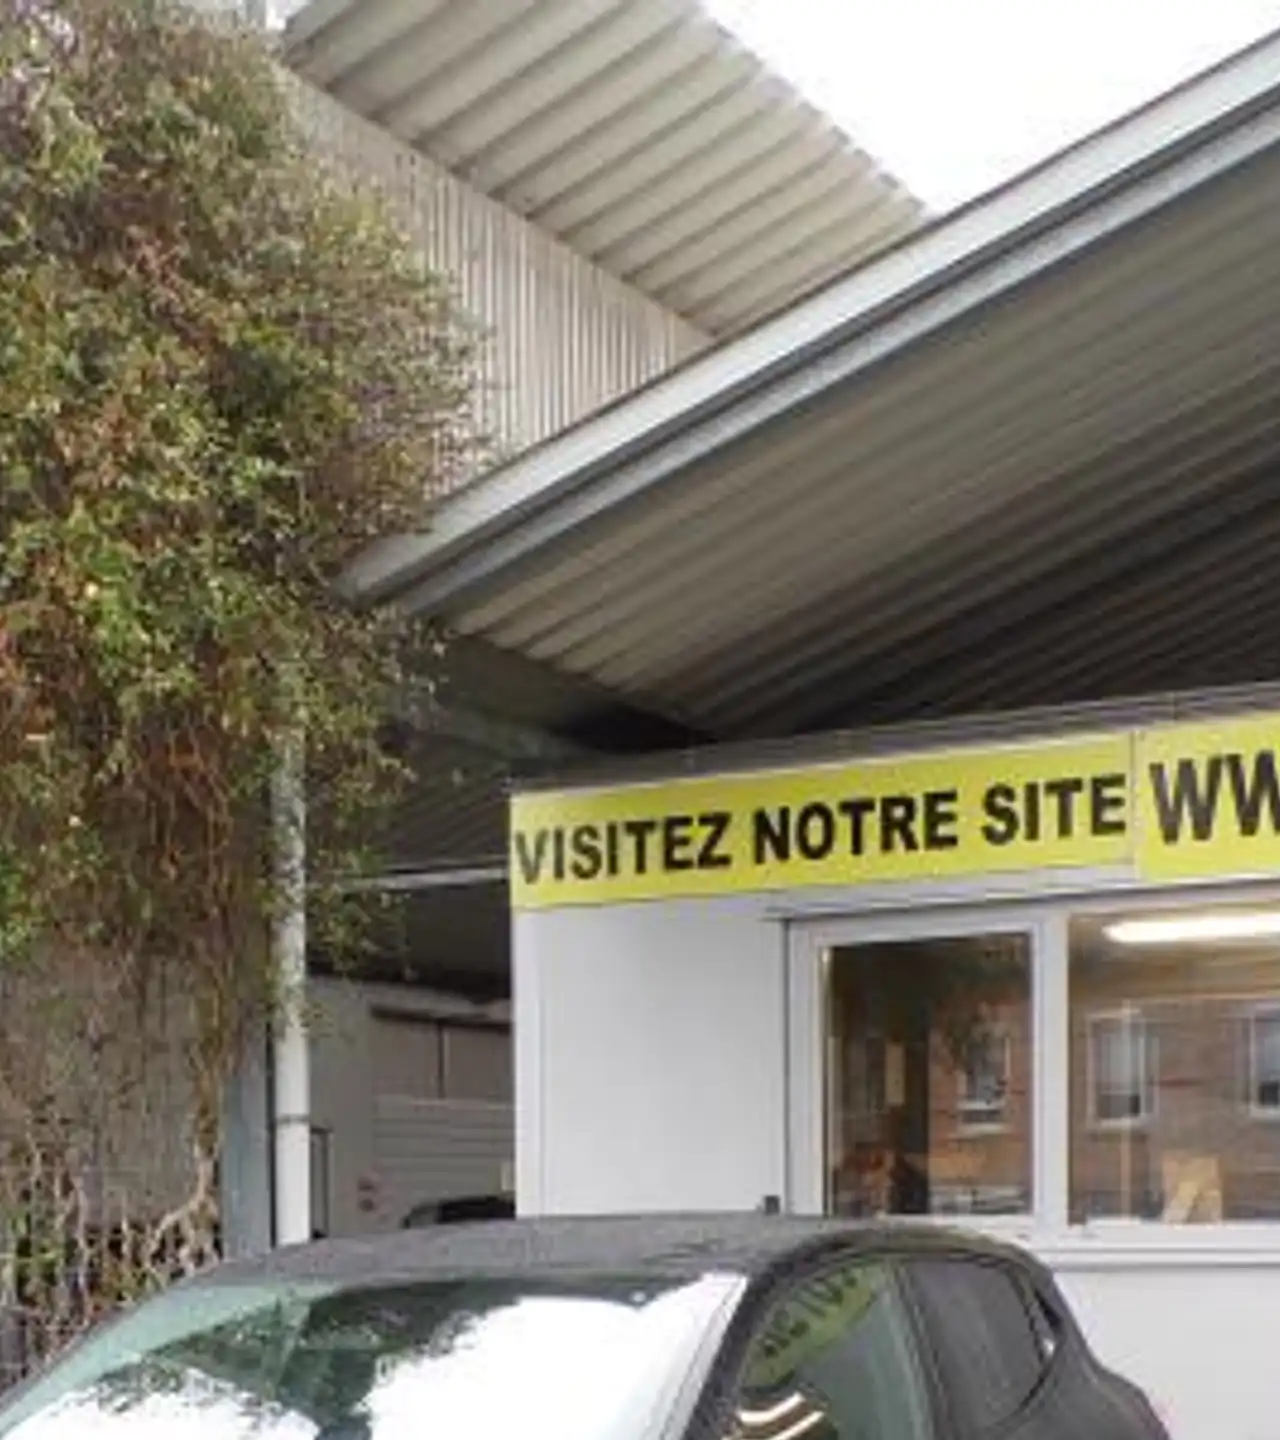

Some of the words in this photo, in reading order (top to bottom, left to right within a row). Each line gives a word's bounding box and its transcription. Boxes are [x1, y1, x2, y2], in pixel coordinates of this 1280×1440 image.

[515, 810, 734, 885] VISITEZ
[751, 788, 960, 866] NOTRE
[979, 773, 1128, 846] SITE
